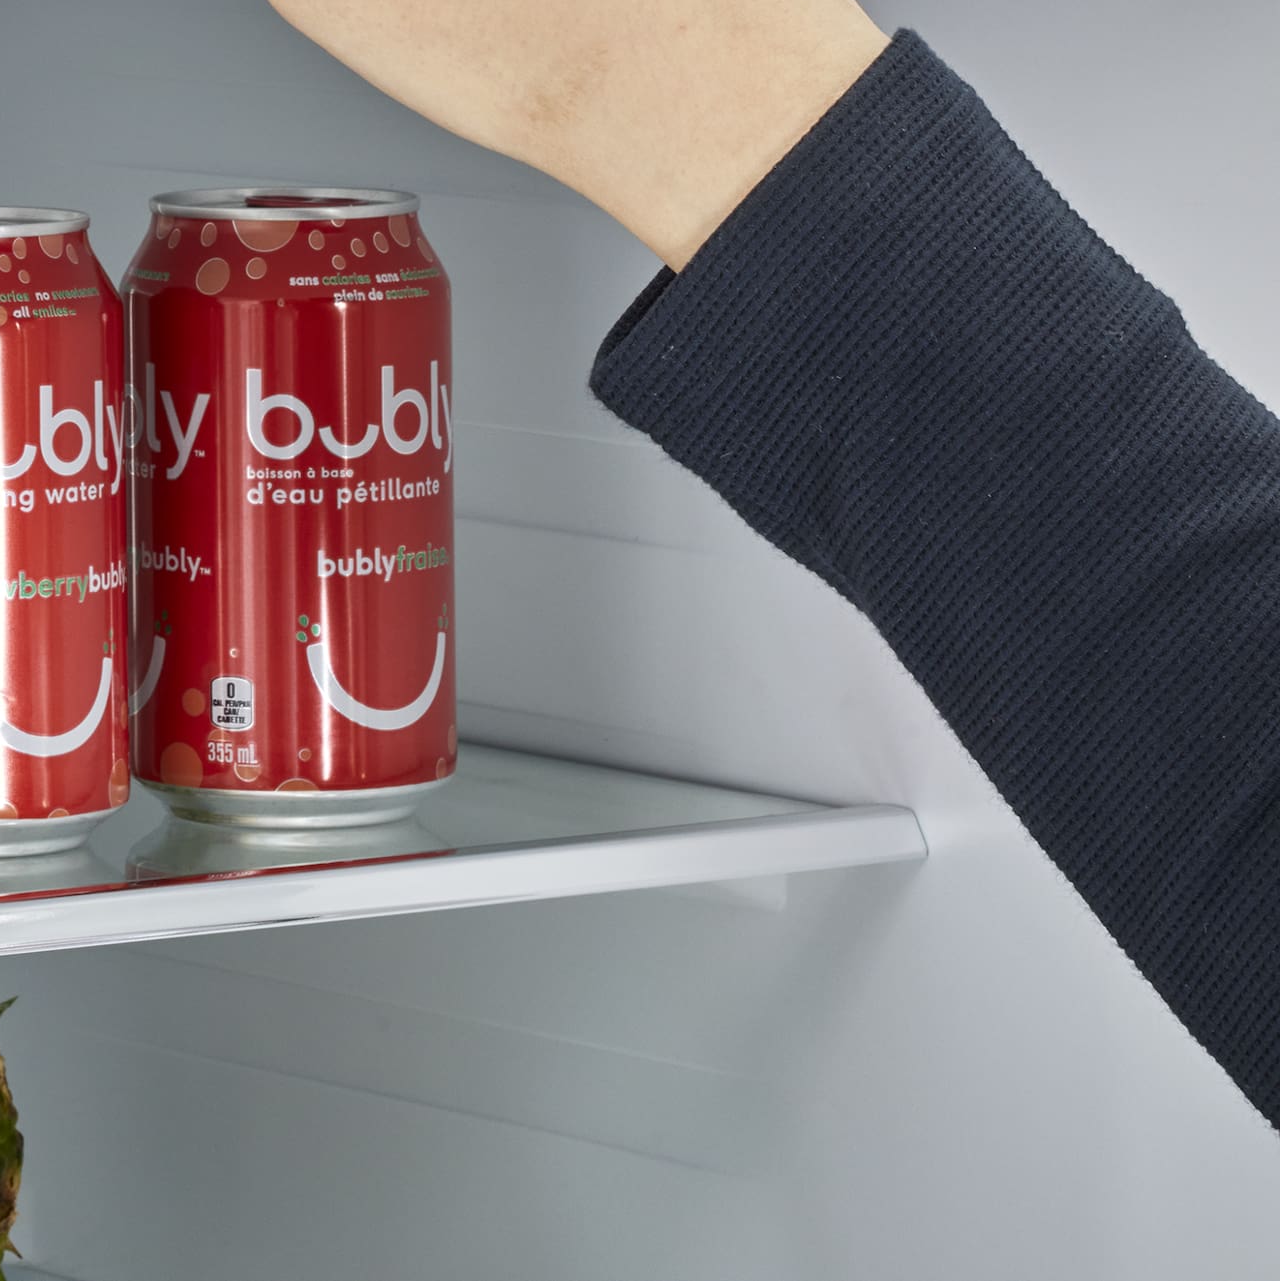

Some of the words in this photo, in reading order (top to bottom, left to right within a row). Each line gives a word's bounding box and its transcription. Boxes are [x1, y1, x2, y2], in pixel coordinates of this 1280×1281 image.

[289, 275, 319, 286] sans
[35, 290, 50, 301] no
[368, 288, 383, 300] de
[12, 305, 30, 318] all
[246, 360, 453, 474] bubly
[246, 465, 301, 480] boisson
[321, 466, 354, 479] base
[45, 481, 104, 505] water
[247, 482, 324, 505] d'eau
[337, 477, 439, 509] pétillante
[208, 742, 233, 763] 355
[237, 743, 258, 764] mL
